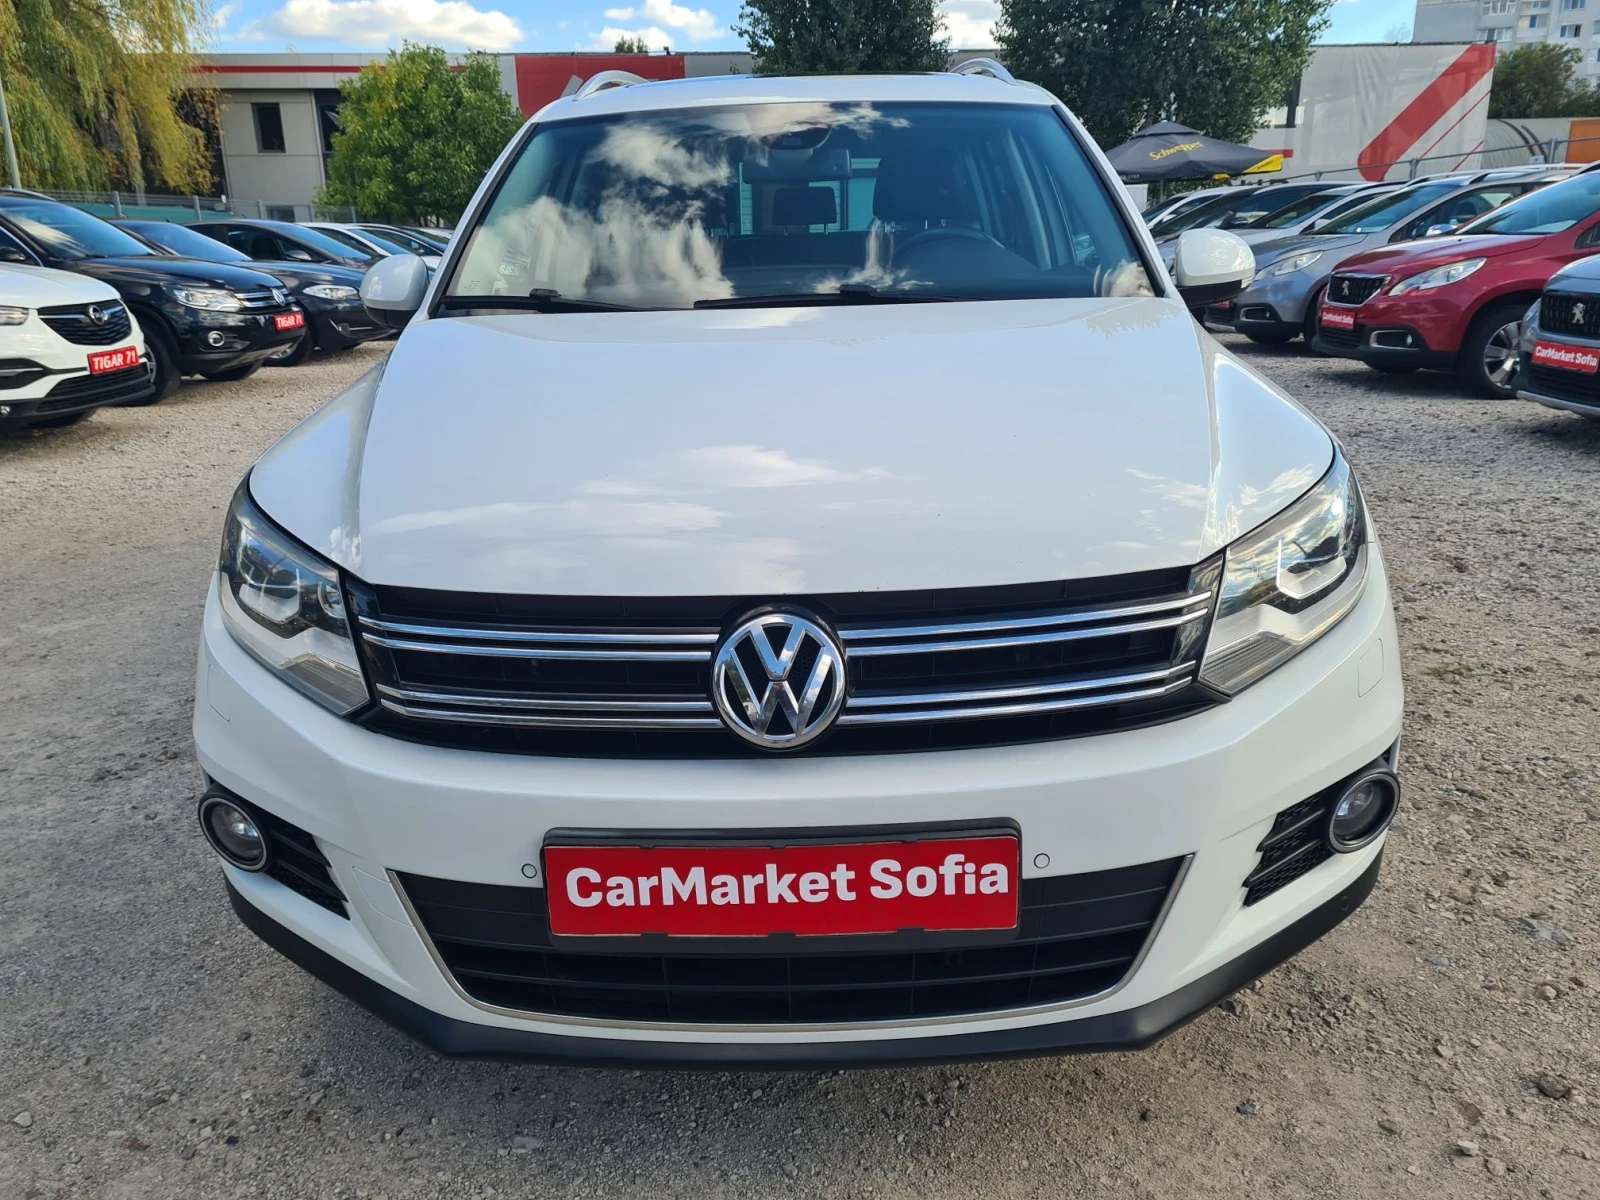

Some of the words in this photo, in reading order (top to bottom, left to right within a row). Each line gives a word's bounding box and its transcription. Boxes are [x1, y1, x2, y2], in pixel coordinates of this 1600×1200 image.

[1149, 140, 1204, 161] Schweppes
[276, 316, 295, 328] TIGAR
[92, 353, 124, 370] TIGAR
[126, 350, 136, 364] 71
[1535, 346, 1575, 362] CarMarket
[1575, 353, 1597, 366] Sofia
[565, 863, 857, 908] CarMarket
[869, 853, 1010, 900] Sofia
